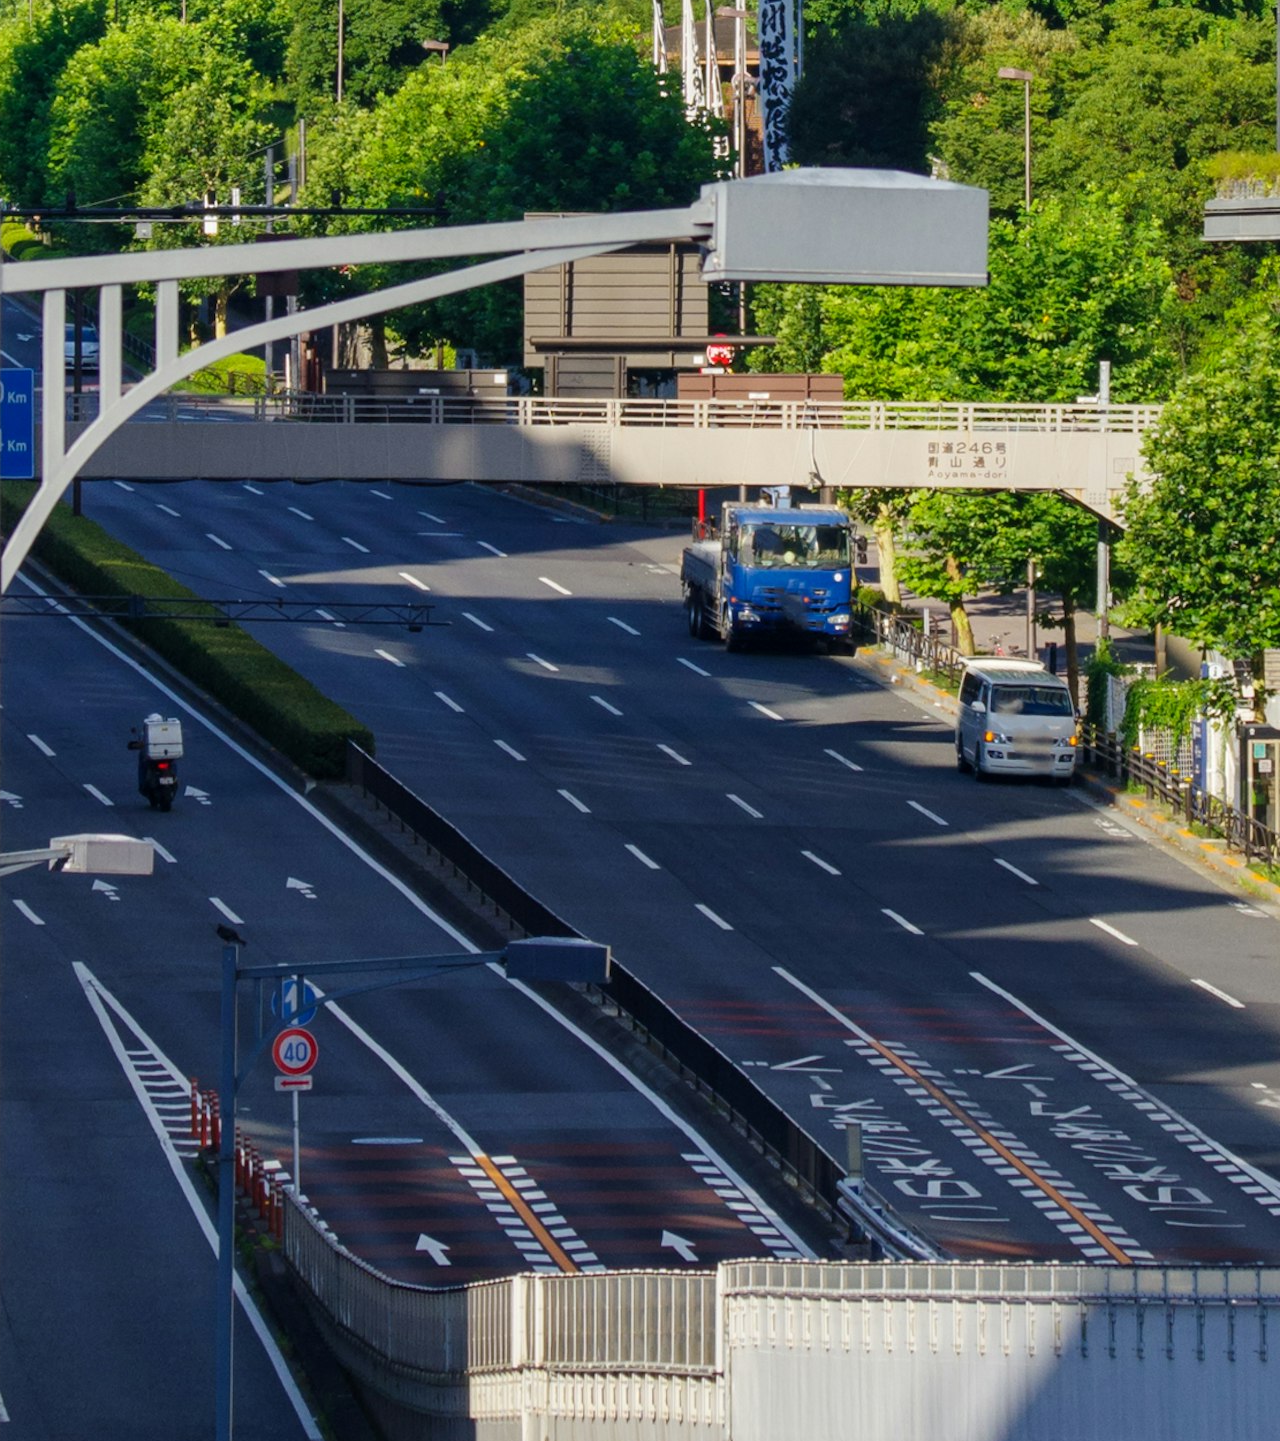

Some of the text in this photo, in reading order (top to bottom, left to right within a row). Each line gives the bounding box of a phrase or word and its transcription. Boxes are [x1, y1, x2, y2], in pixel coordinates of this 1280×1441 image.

[7, 391, 28, 404] Km
[7, 440, 28, 452] Km
[928, 442, 1007, 454] 国道246号
[928, 456, 1007, 469] 青山通り
[928, 470, 1008, 480] Aoyama-dori
[283, 1041, 308, 1062] 40
